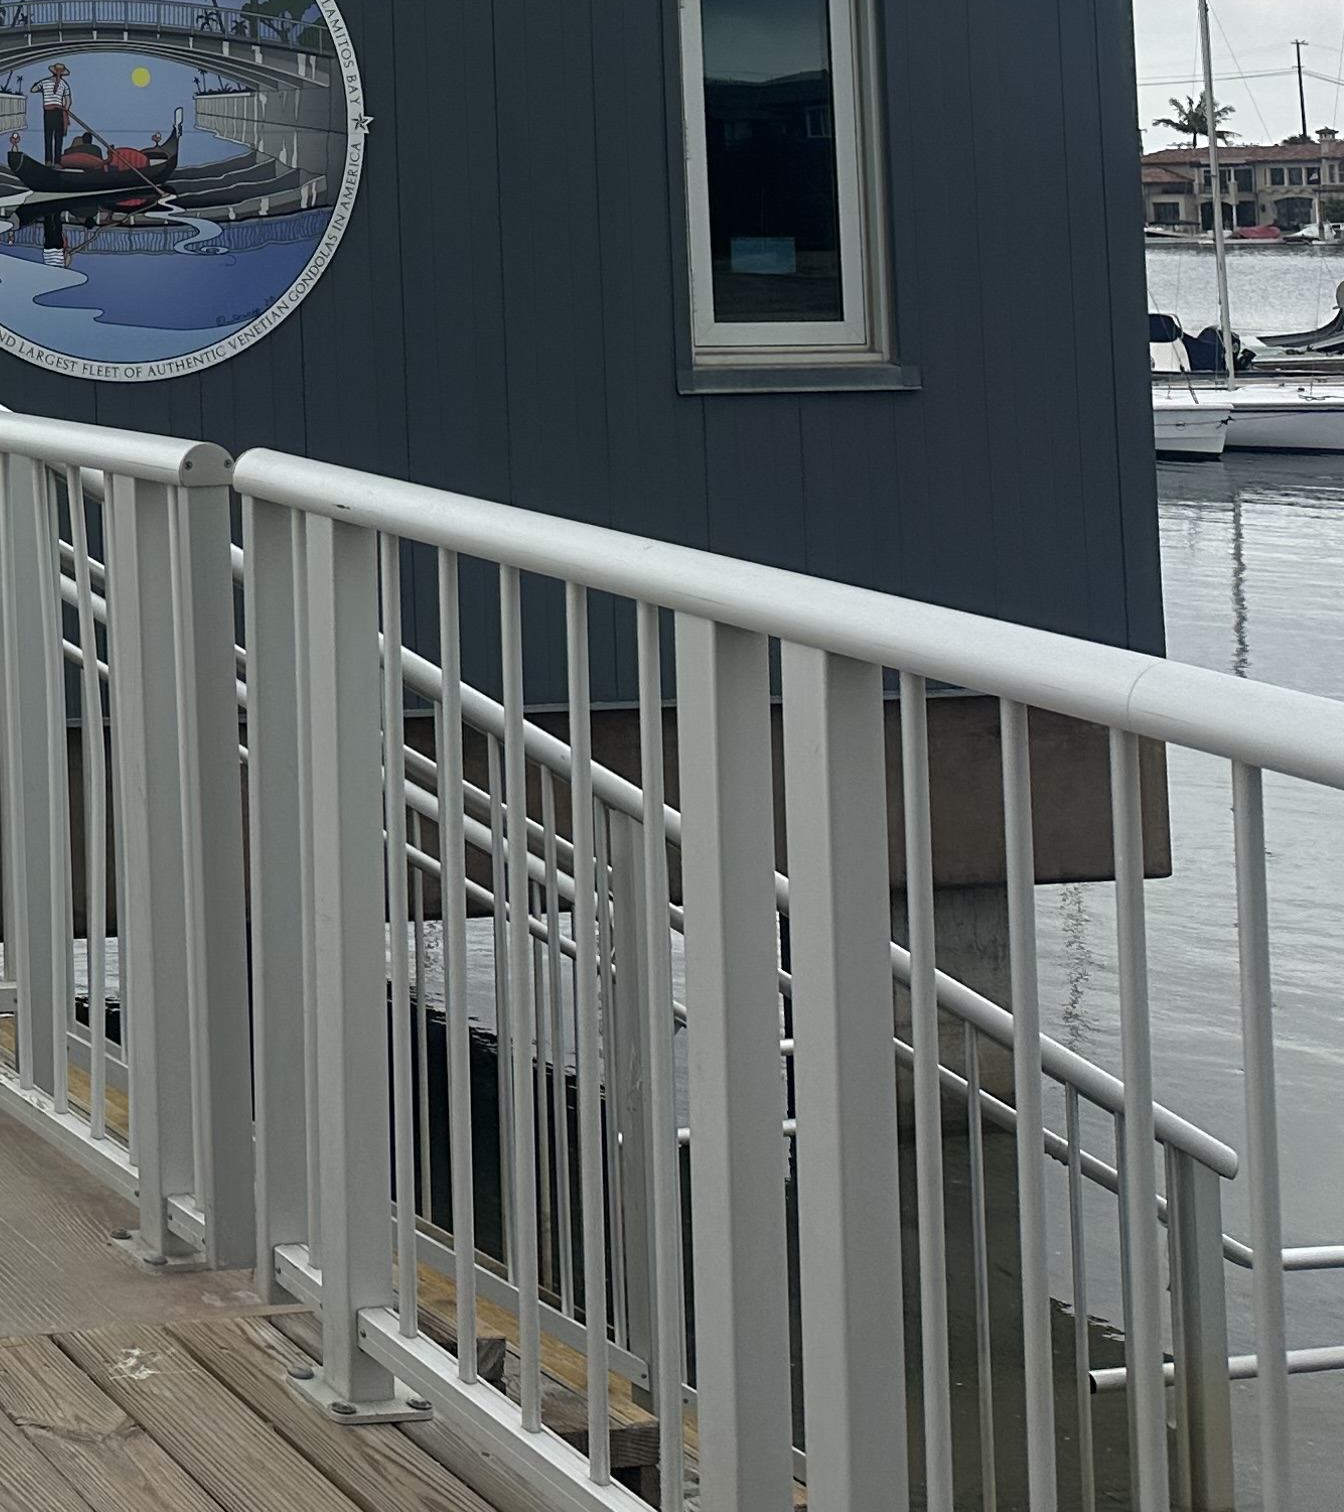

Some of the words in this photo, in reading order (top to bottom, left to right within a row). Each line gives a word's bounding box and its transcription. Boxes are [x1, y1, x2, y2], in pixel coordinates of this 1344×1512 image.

[346, 74, 361, 105] BAY
[18, 341, 79, 373] LARGEST
[81, 363, 120, 379] FLEET
[123, 365, 143, 379] OF
[147, 345, 227, 377] AUTHENTIC
[228, 300, 290, 351] VENETIAN
[288, 234, 338, 303] GONDOLAS
[331, 213, 346, 232] IN
[340, 142, 362, 211] AMERICA
